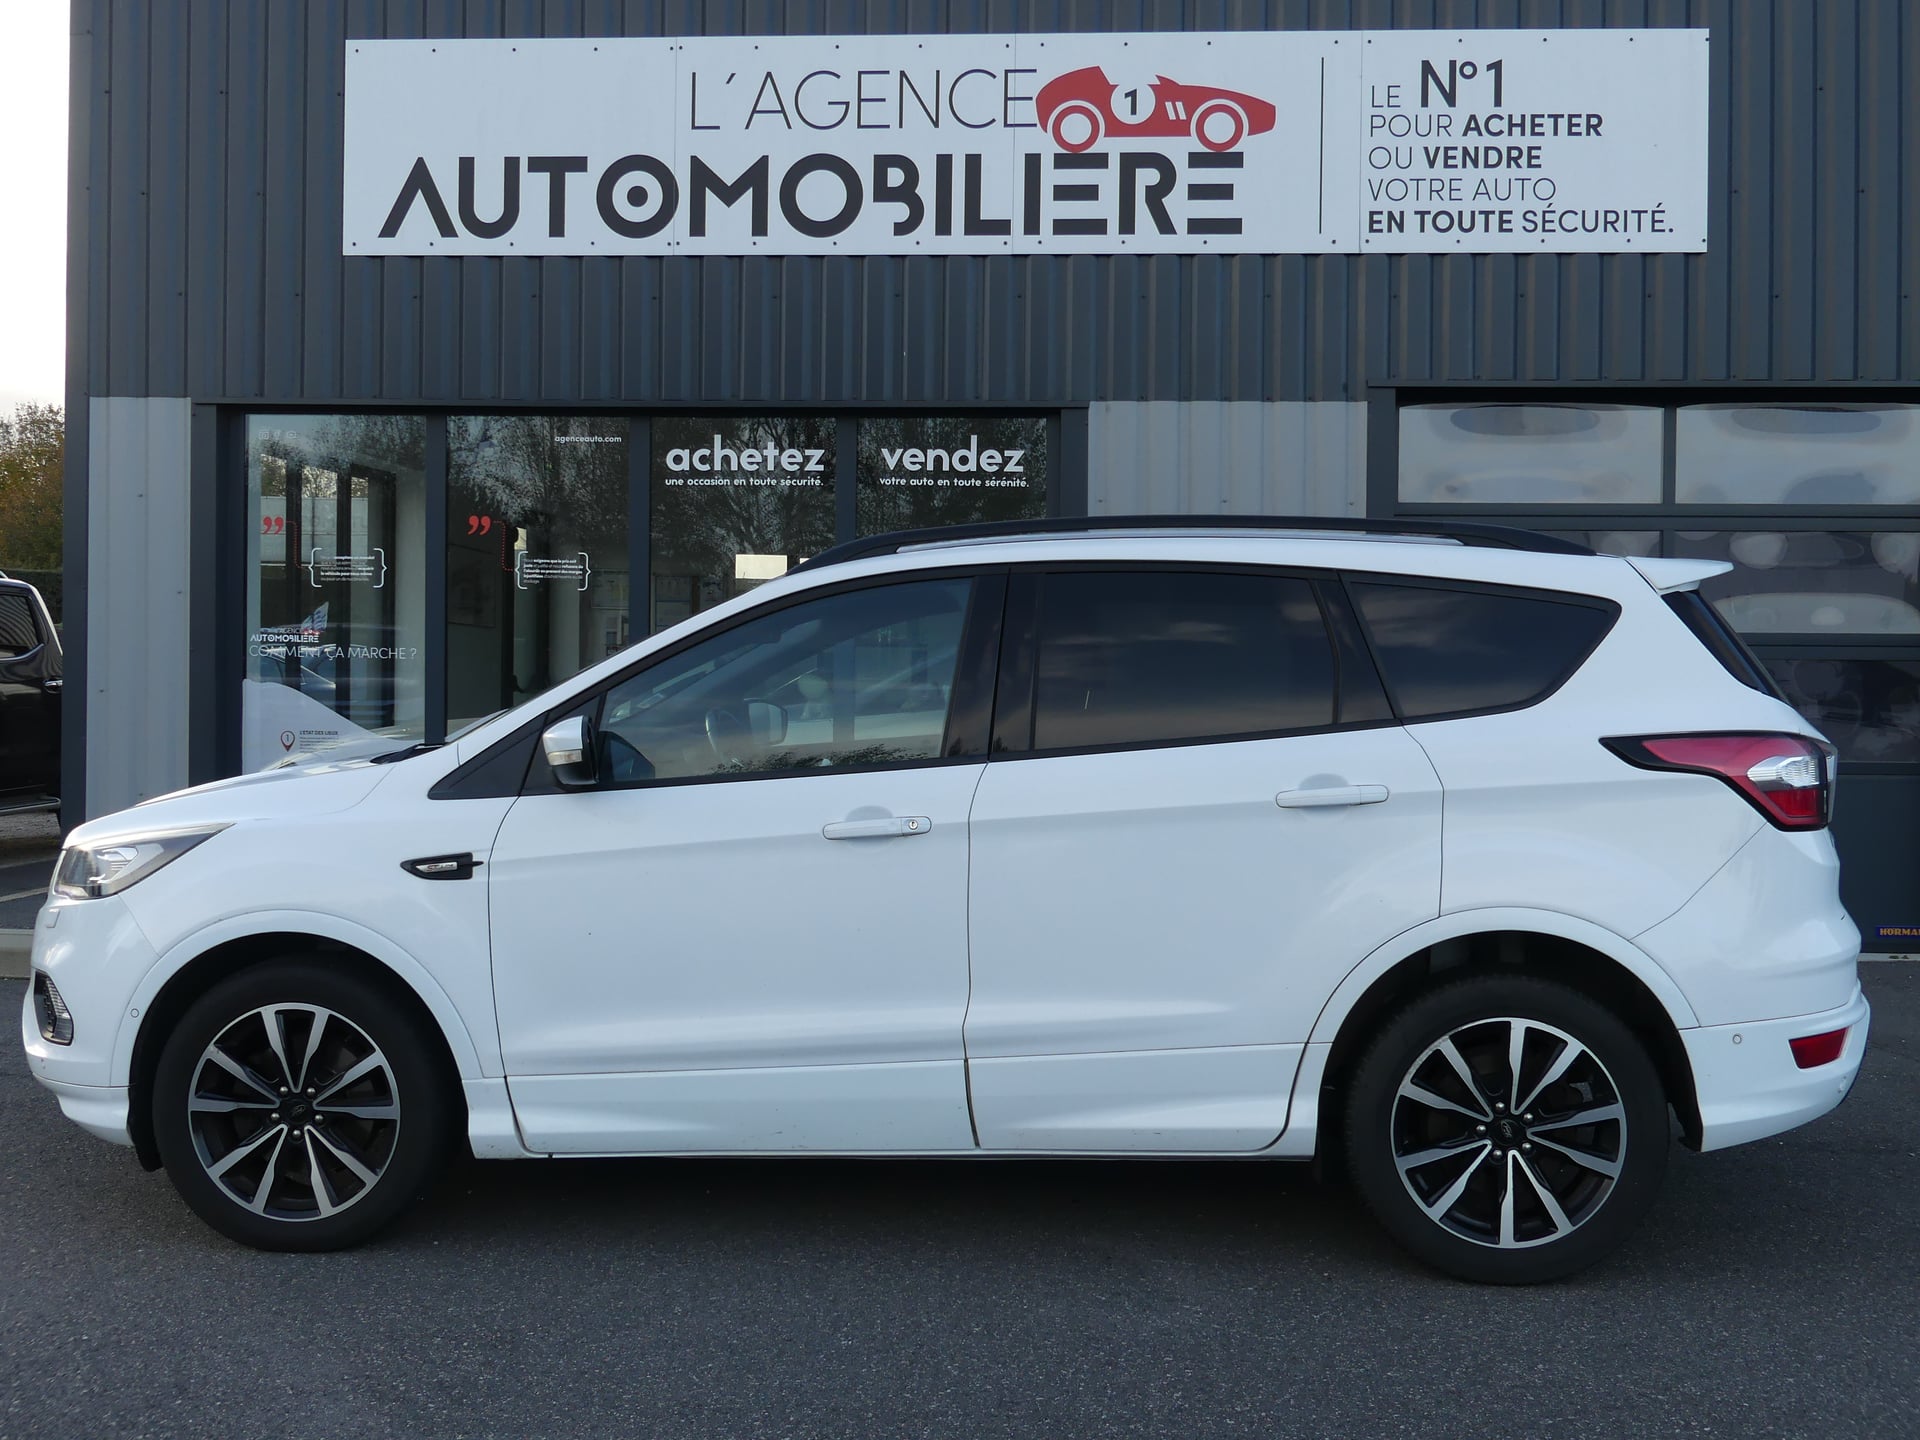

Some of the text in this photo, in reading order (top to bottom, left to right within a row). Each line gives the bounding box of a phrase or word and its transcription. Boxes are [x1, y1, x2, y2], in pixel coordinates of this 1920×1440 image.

[690, 67, 1038, 131] L'AGENCE
[1123, 88, 1138, 116] 1
[1371, 85, 1401, 108] LE
[1369, 112, 1604, 138] POUR ACHETER
[1368, 145, 1543, 170] OU VENDRE
[1367, 177, 1557, 202] VOTRE AUTO
[1368, 202, 1674, 234] EN TOUTE SÉCURITÉ.
[554, 435, 622, 444] agenceauto.com
[665, 434, 825, 472] achetez
[881, 434, 1025, 473] vendez
[665, 475, 824, 487] une occasion en toute sécurité.
[879, 476, 1030, 489] votre auto en toute sérénité.
[249, 645, 322, 658] COMMENT
[326, 646, 345, 662] ÇA
[347, 647, 407, 660] MARCHE
